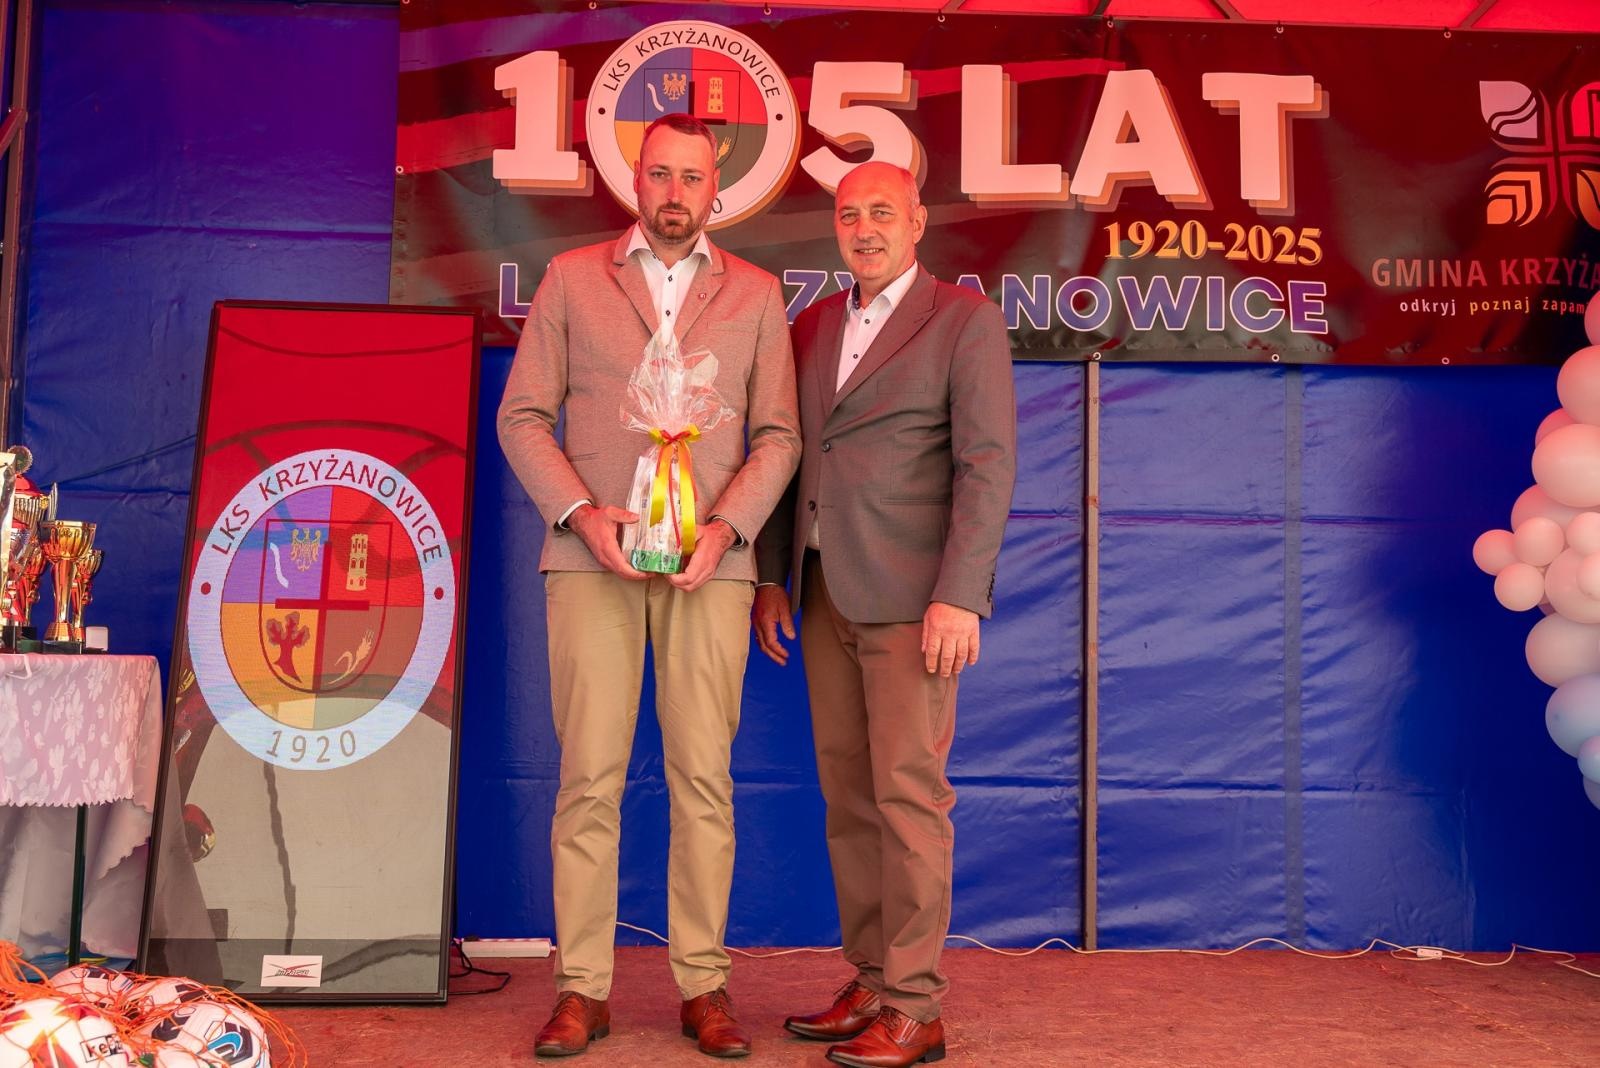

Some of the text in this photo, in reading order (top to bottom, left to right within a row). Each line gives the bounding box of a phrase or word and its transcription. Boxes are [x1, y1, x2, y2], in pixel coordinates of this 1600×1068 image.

[603, 27, 780, 98] LKS KRZYŻANOWICE
[961, 64, 1320, 205] LAT
[1103, 219, 1323, 266] 1920-2025
[1371, 257, 1488, 288] GMINA
[1399, 296, 1588, 316] odkryj poznaj zapam
[211, 454, 442, 563] LKS KRZYŻANOWICE
[266, 729, 356, 764] 1920
